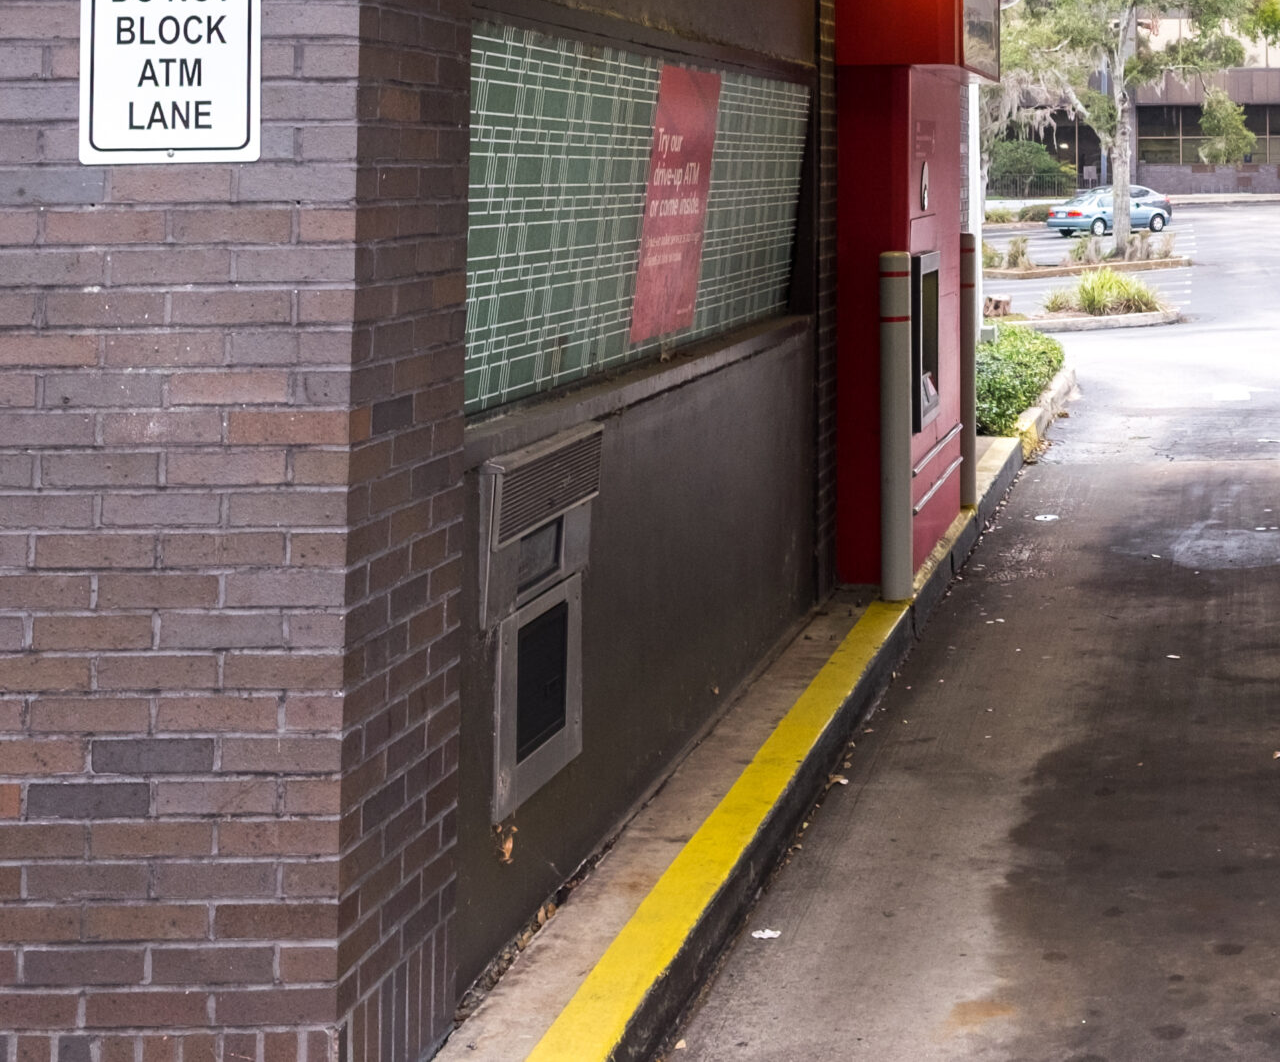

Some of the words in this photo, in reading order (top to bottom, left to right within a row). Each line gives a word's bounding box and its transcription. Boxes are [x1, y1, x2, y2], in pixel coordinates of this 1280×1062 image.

[116, 15, 227, 45] BLOCK
[137, 58, 202, 88] ATM
[128, 100, 212, 130] LANE
[658, 128, 669, 159] Try
[670, 136, 683, 152] our
[653, 161, 683, 192] drive-up
[684, 162, 701, 185] ATM
[650, 199, 658, 218] or
[660, 199, 678, 216] come
[679, 191, 700, 215] inside.
